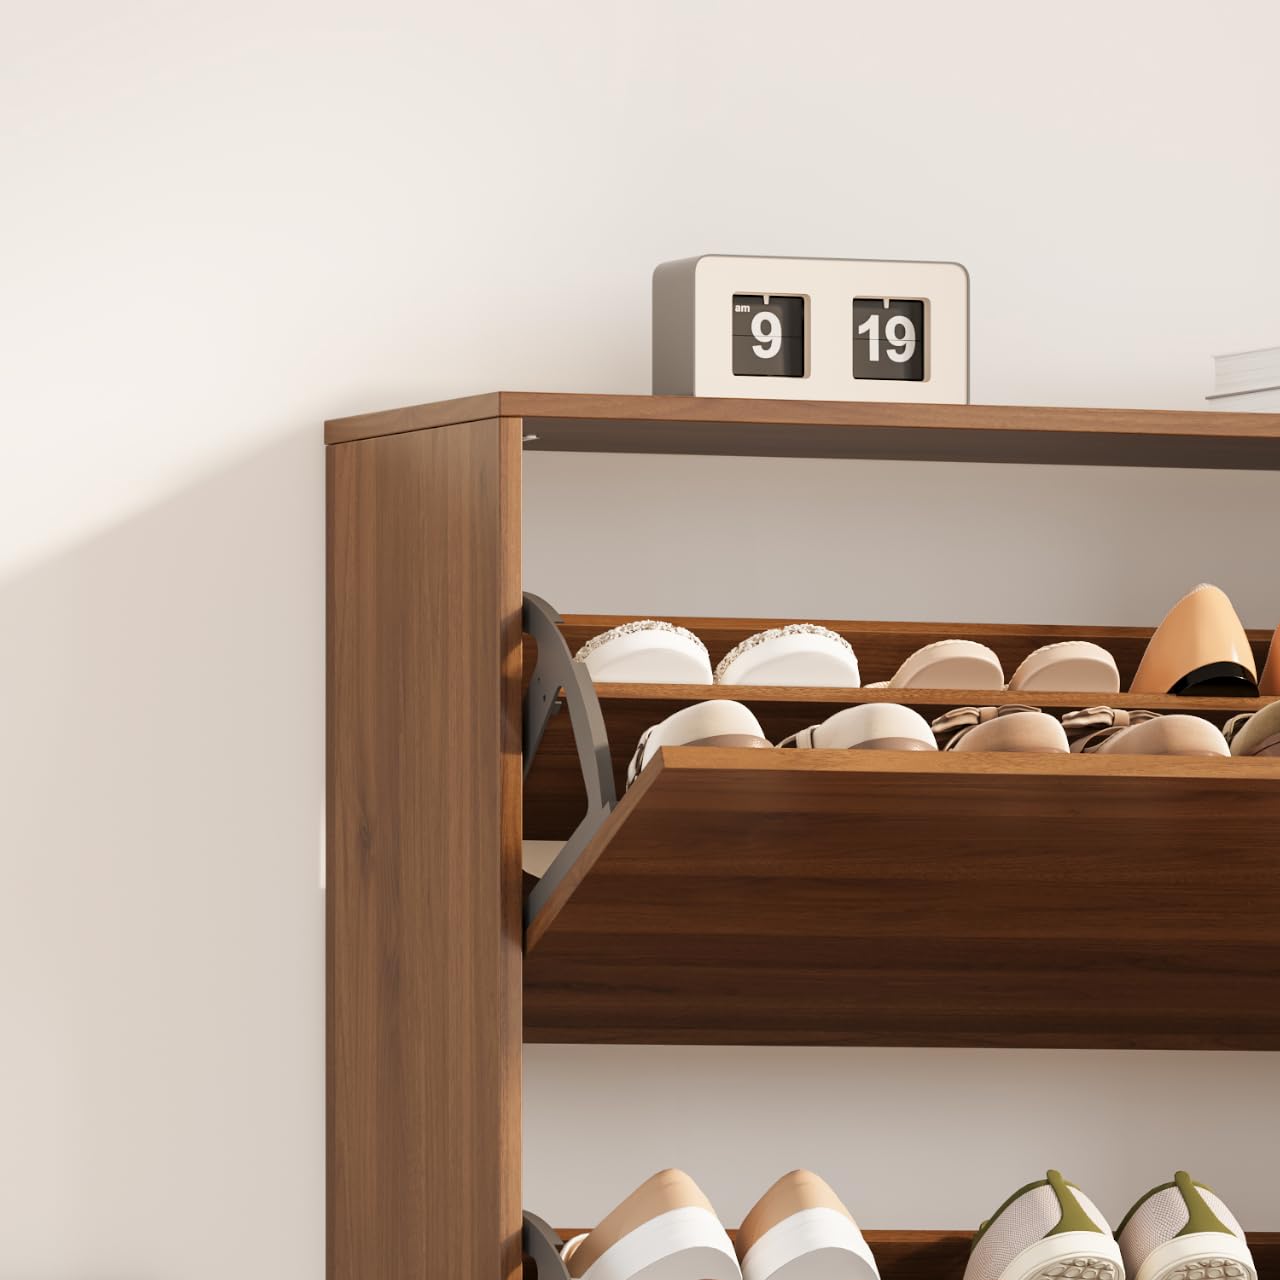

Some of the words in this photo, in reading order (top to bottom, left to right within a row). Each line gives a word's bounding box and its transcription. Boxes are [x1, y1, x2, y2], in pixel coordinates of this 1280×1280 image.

[734, 304, 750, 313] am
[751, 311, 783, 359] 9
[857, 314, 917, 363] 19
